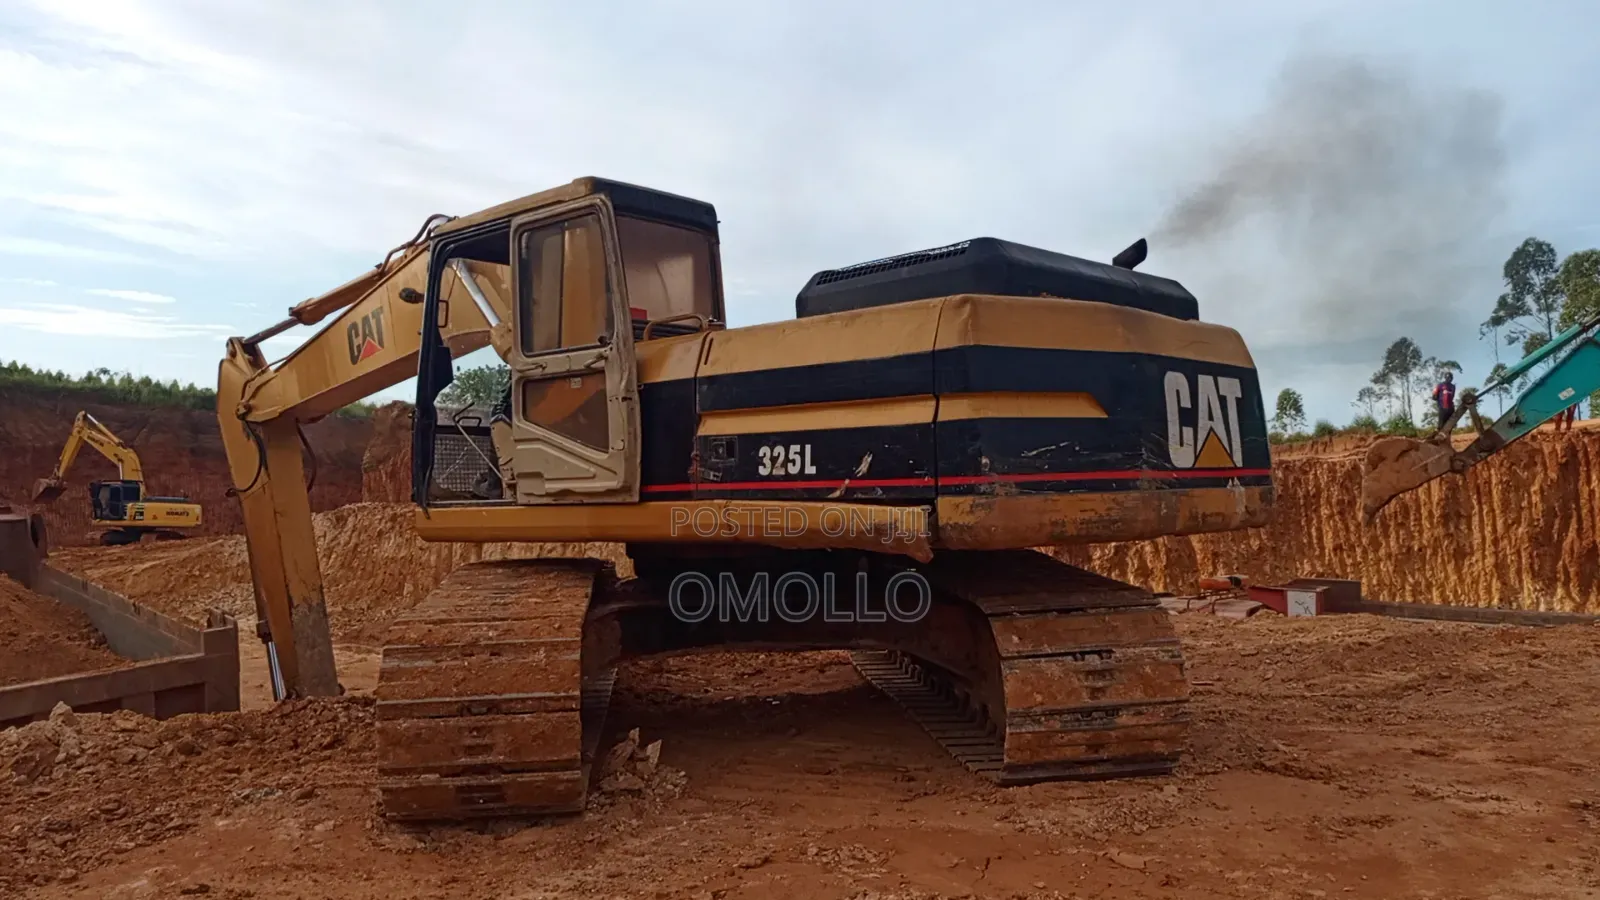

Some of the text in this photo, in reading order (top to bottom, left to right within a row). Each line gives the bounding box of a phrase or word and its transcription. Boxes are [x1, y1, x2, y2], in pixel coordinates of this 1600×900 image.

[347, 306, 384, 365] CAT
[1164, 371, 1243, 468] CAT
[758, 444, 816, 476] 325L
